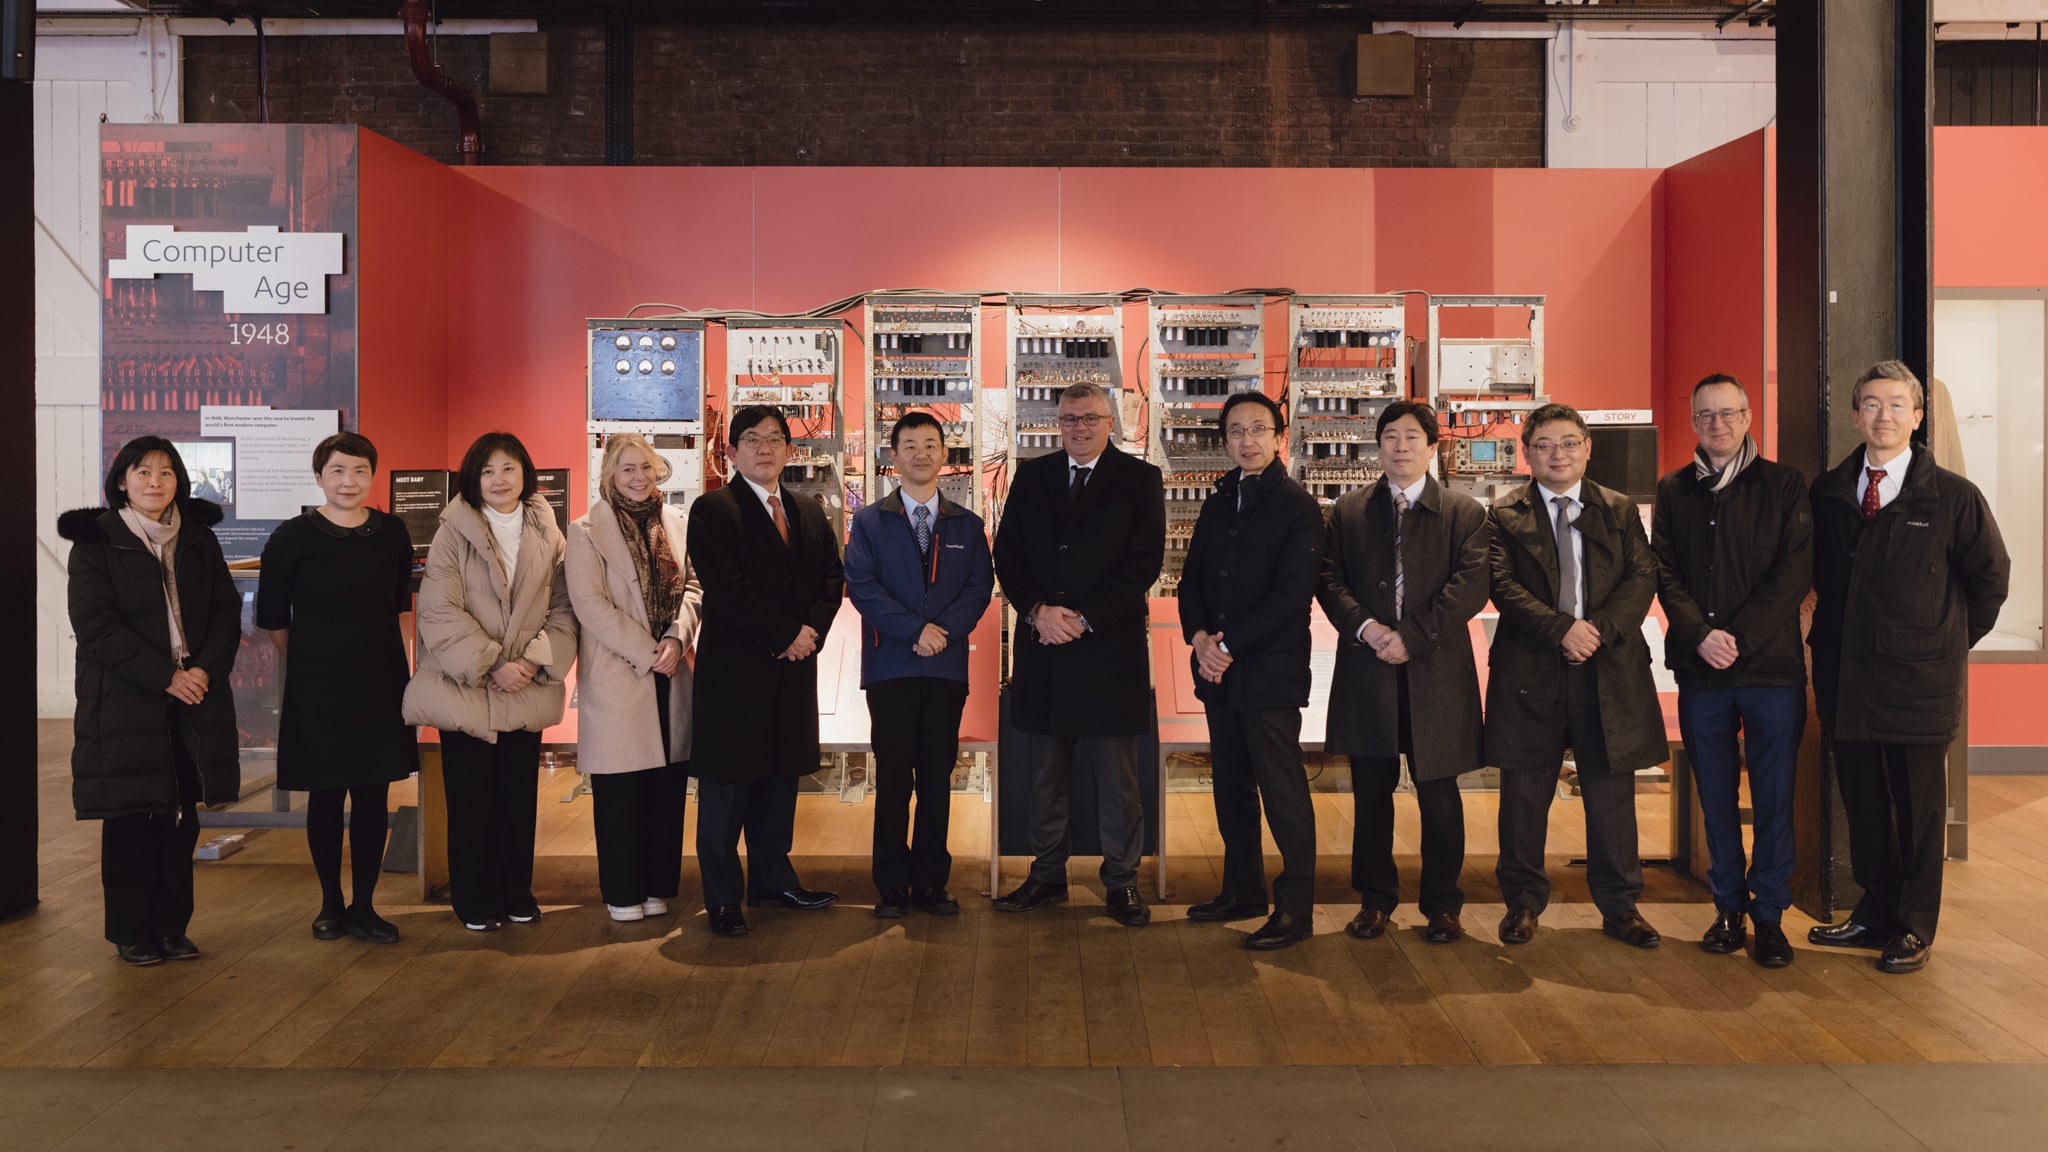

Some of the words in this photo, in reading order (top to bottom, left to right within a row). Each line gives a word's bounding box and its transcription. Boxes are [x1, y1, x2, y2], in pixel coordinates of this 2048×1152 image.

[143, 239, 285, 269] Computer
[254, 276, 309, 305] Age
[229, 323, 290, 345] 1948
[1604, 412, 1637, 421] STORY
